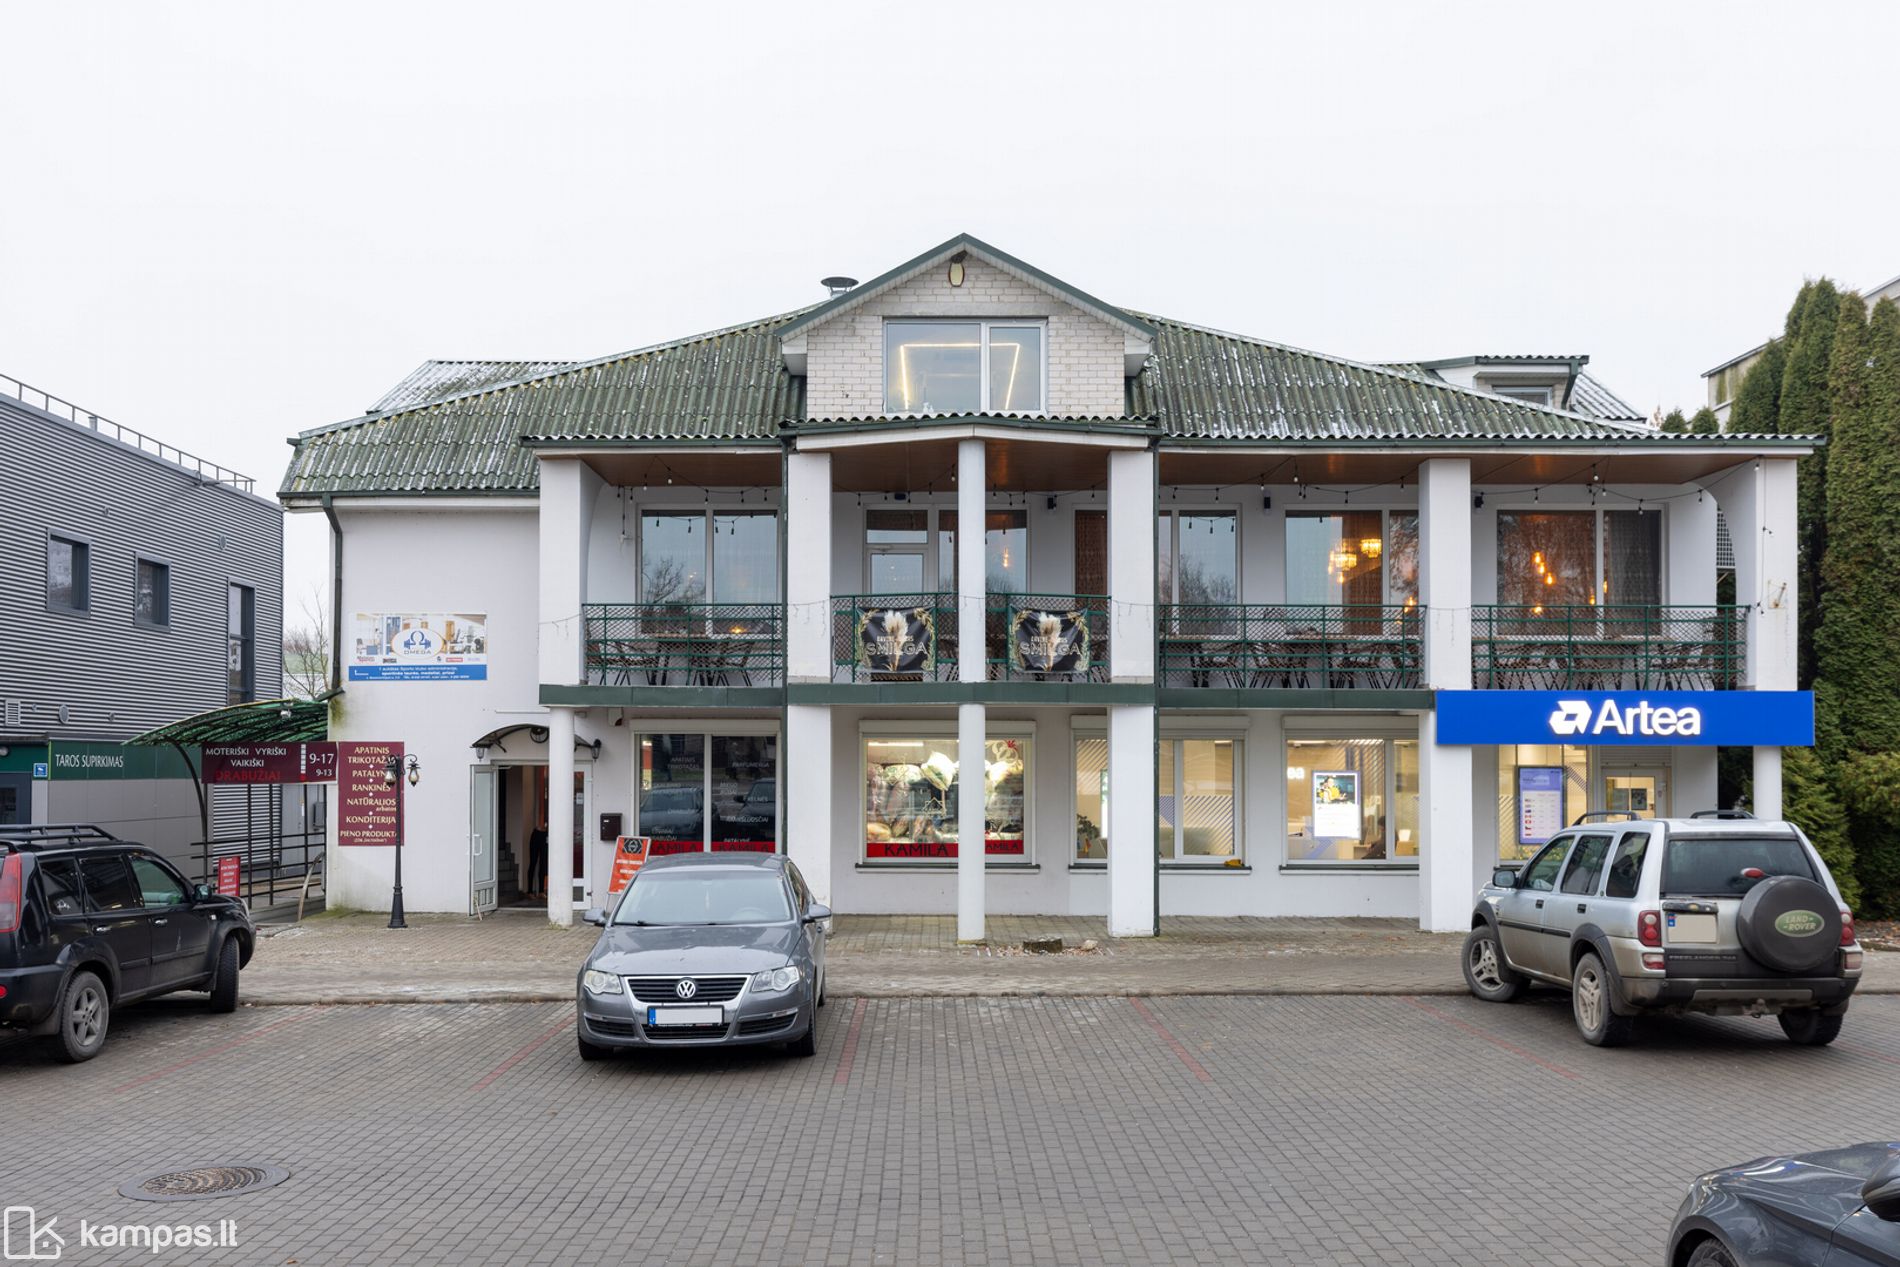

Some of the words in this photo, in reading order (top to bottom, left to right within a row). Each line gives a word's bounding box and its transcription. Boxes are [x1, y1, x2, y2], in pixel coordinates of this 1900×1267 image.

[865, 641, 928, 656] SMILGA
[1019, 641, 1081, 657] SMILGA
[1592, 699, 1701, 736] Artea
[205, 746, 249, 755] MOTERIŠKI
[255, 746, 286, 755] VYRIŠKI
[354, 746, 390, 754] APATINIS
[56, 754, 80, 767] TAROS
[81, 754, 124, 768] SUPIRKIMAS
[231, 758, 264, 767] VAIKIŠKI
[309, 753, 334, 765] 9-17
[316, 768, 332, 777] 9-13
[352, 782, 391, 792] RANKINĖS
[346, 797, 397, 806] NATŪRALIOS
[346, 815, 397, 825] KONDITERIJA
[885, 844, 949, 857] KAMILA
